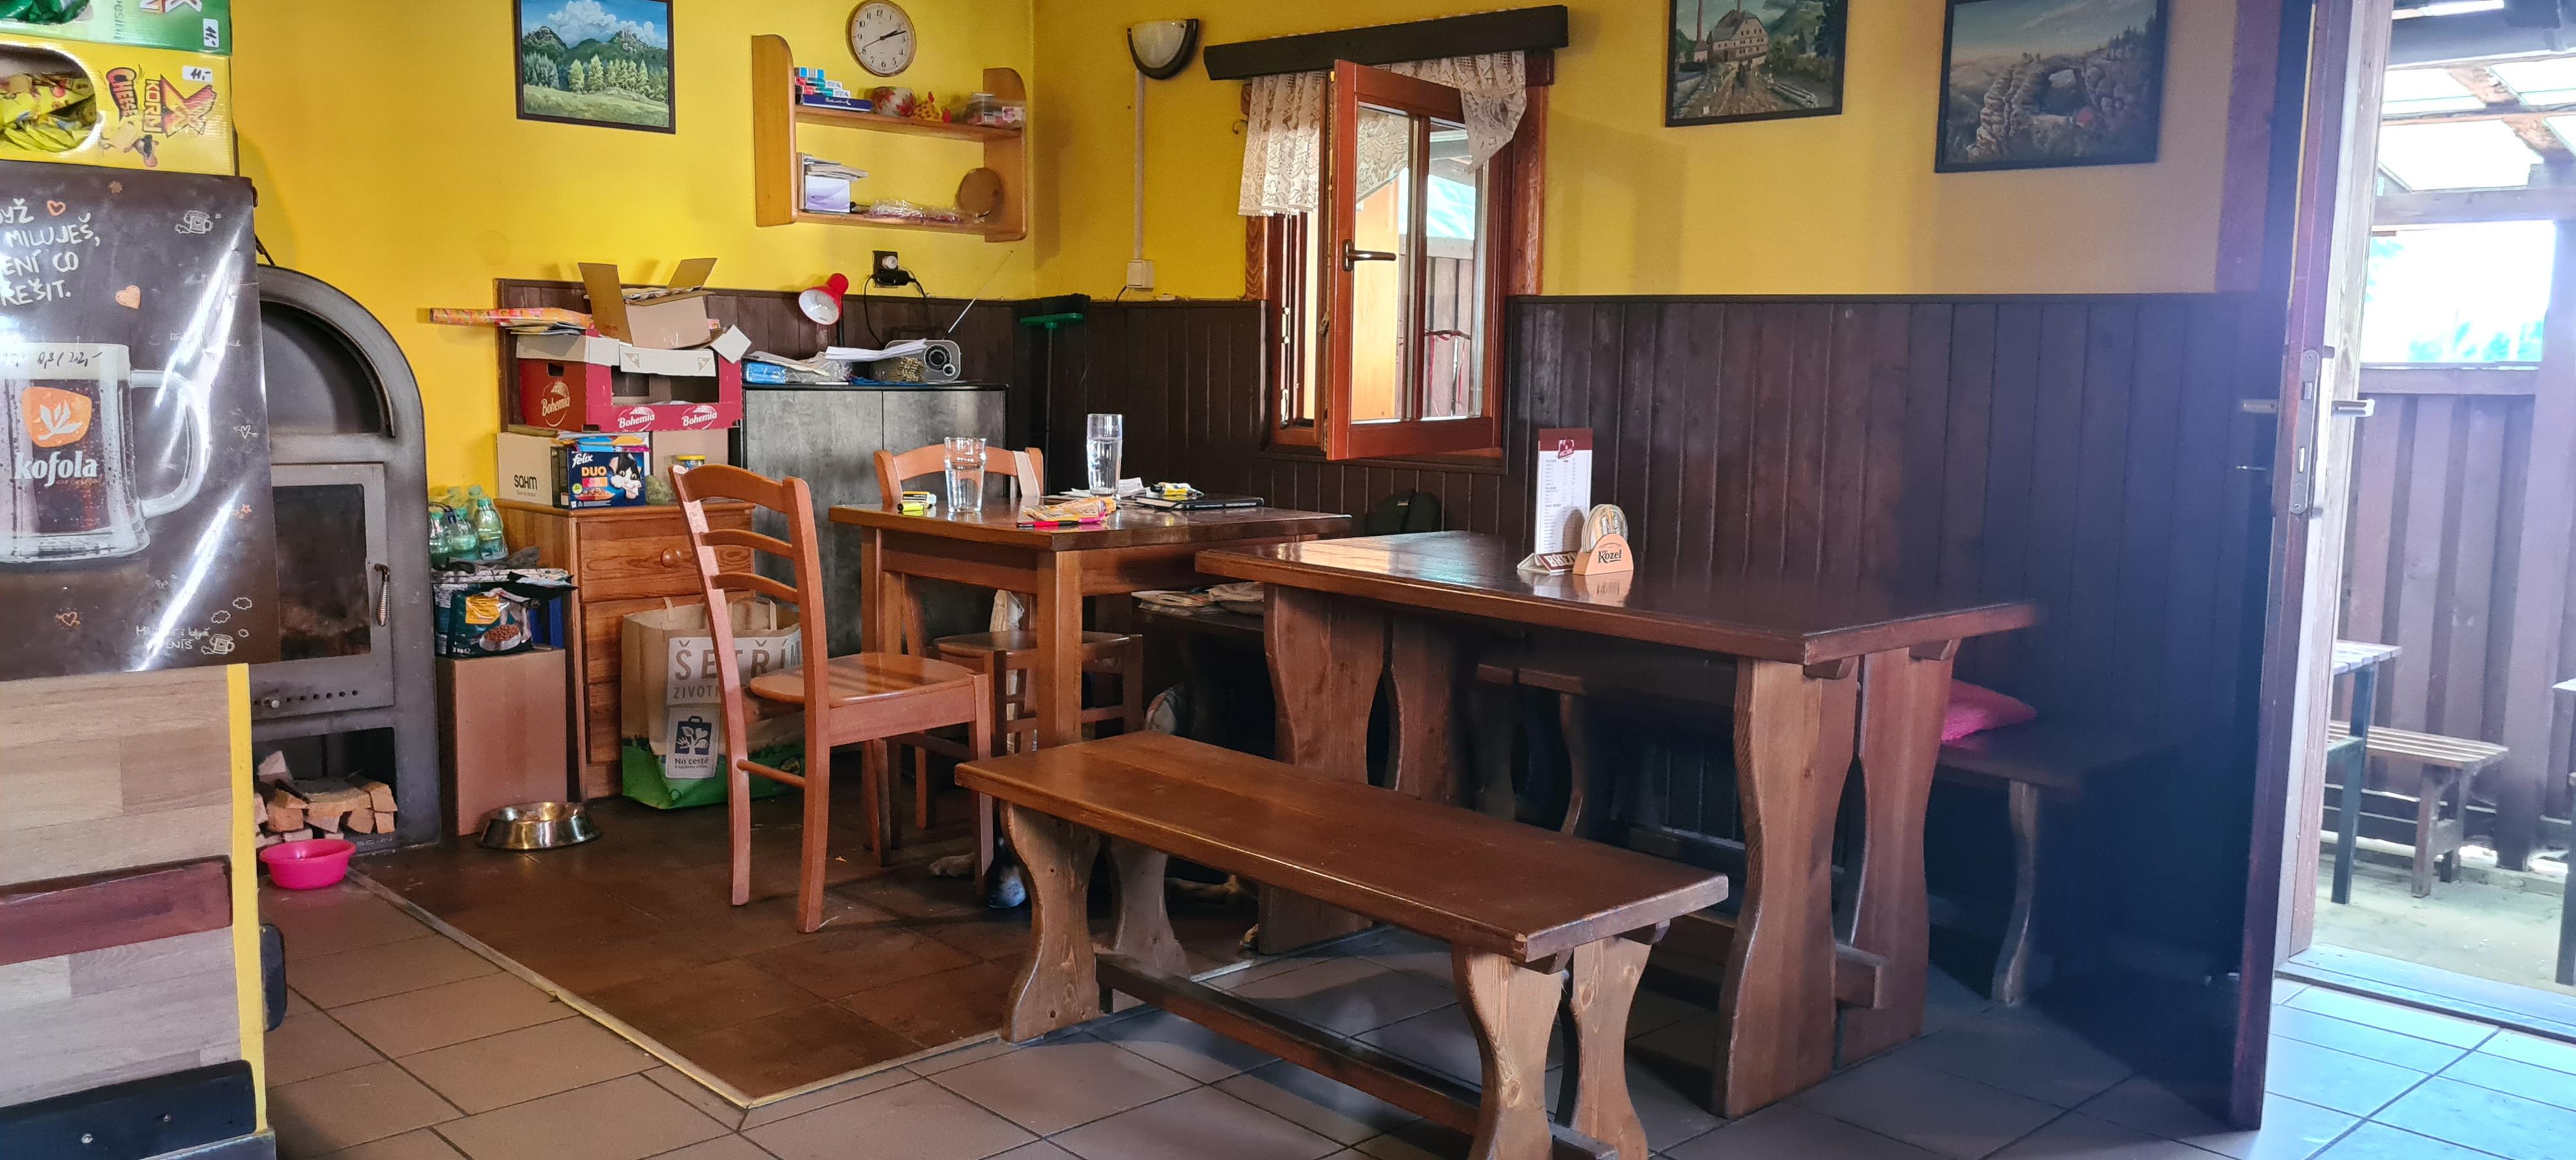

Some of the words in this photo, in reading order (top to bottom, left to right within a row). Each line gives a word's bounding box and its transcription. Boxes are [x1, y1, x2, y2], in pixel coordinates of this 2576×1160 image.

[106, 68, 139, 117] CHEESE
[142, 79, 162, 133] KORN
[0, 198, 35, 223] YŽ
[0, 249, 42, 276] ENÍ
[53, 252, 79, 272] CO
[541, 395, 570, 417] Bohemia
[617, 414, 655, 428] Bohemia
[681, 412, 717, 426] Bohemia
[14, 450, 99, 489] kofola
[582, 466, 607, 477] DUO
[1598, 549, 1622, 564] Kozel
[674, 685, 720, 699] ŽIVOT
